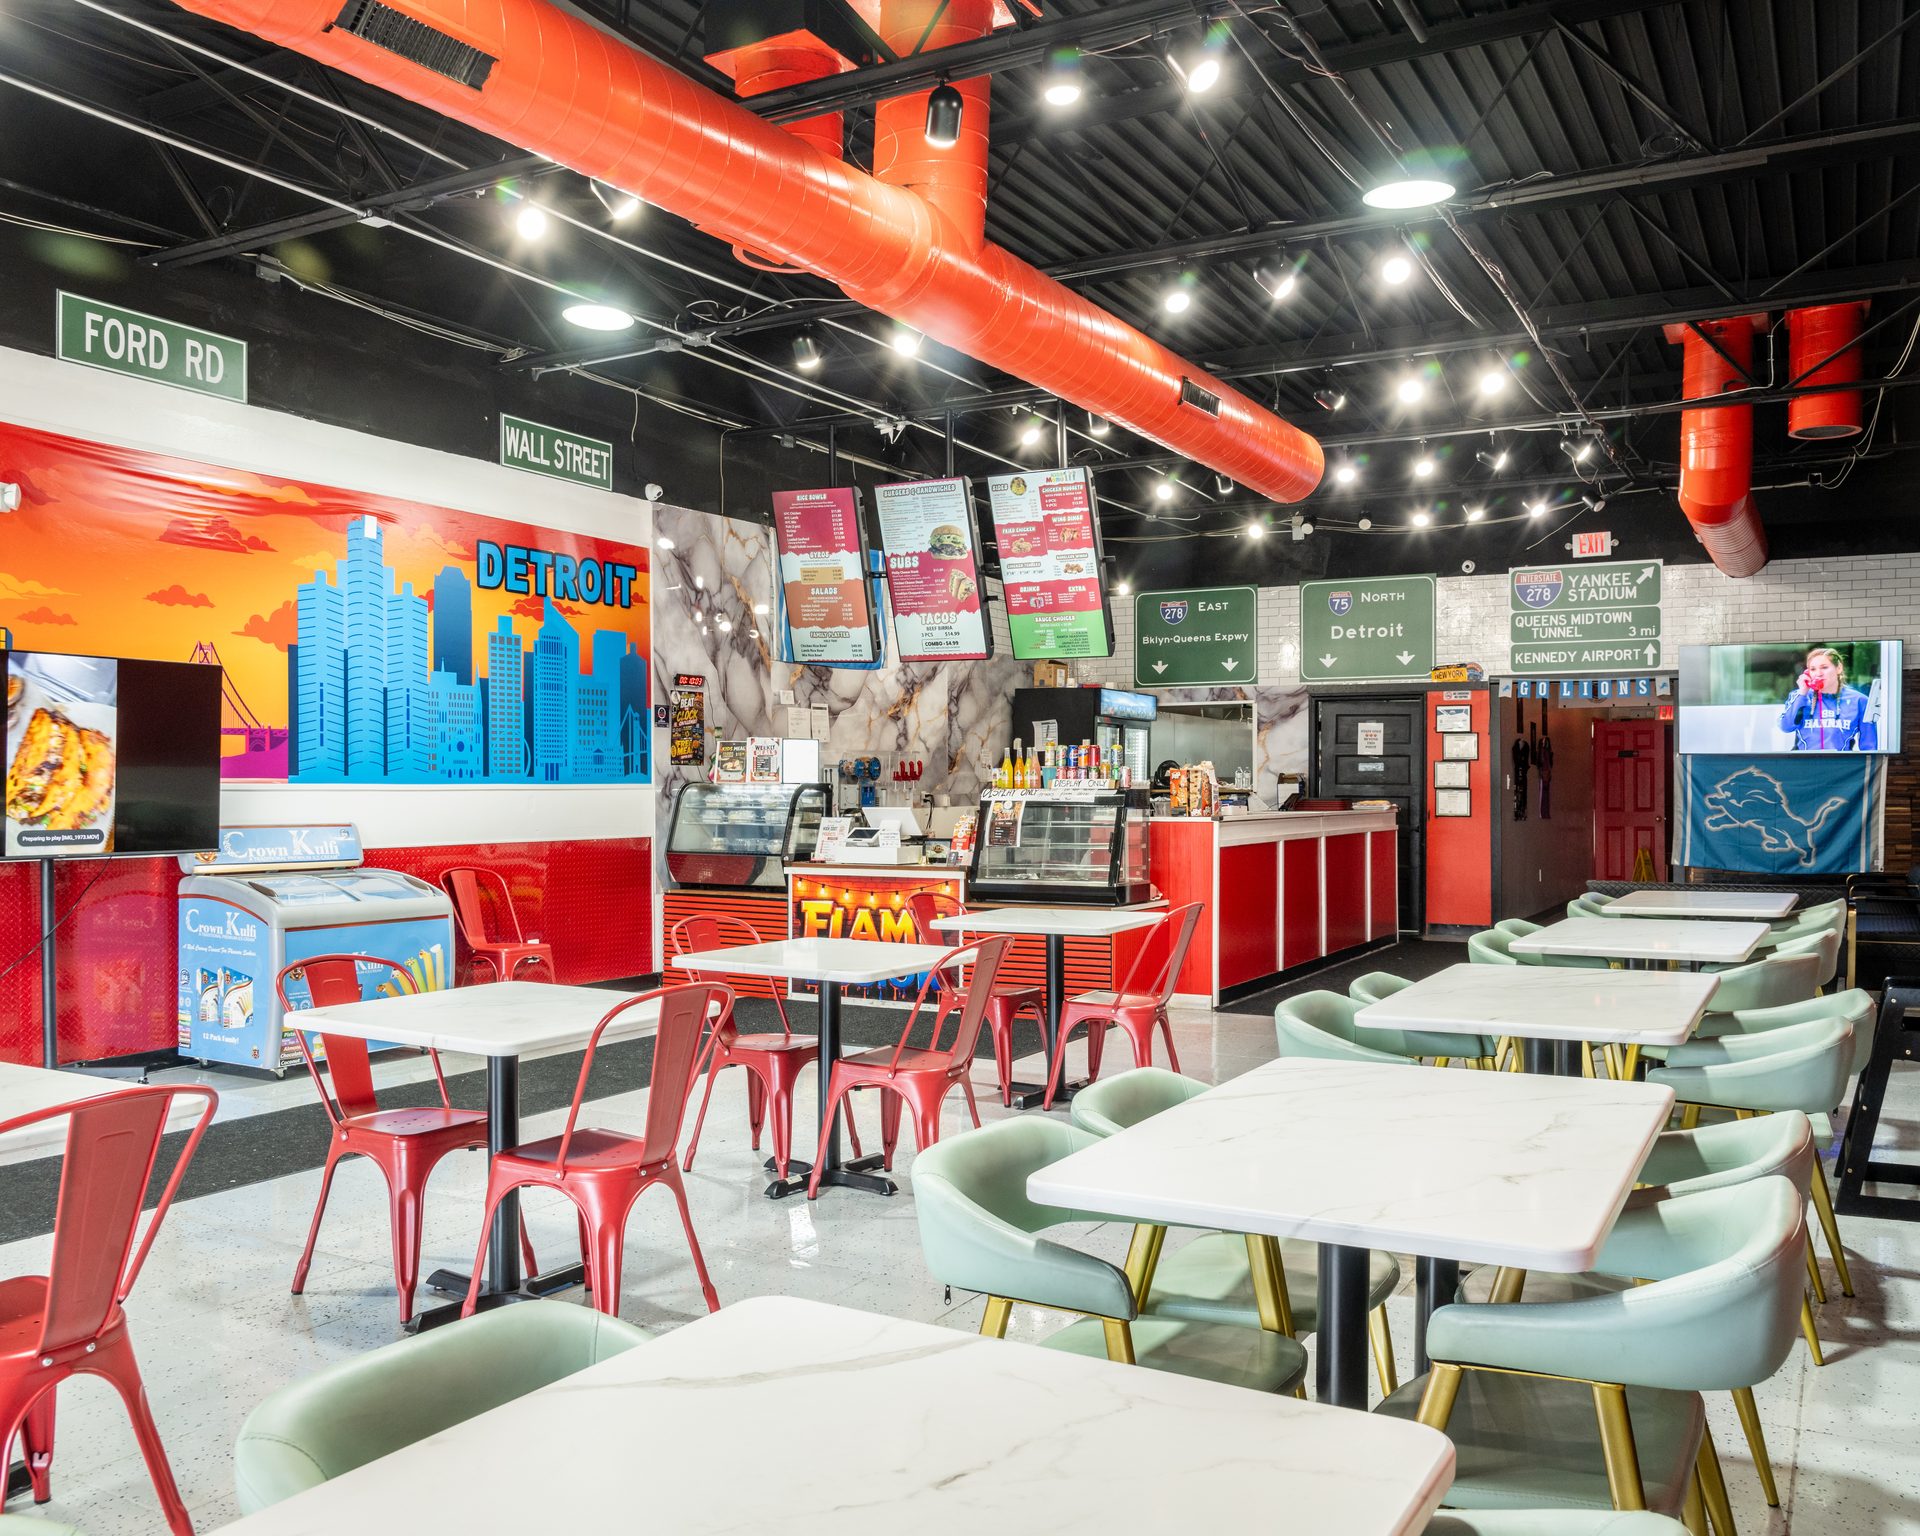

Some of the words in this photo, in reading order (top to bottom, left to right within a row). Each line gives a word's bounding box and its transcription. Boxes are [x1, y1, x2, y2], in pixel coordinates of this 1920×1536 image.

[85, 311, 169, 370] FORD
[185, 338, 225, 384] RD
[505, 425, 551, 466] WALL
[554, 438, 610, 481] STREET
[883, 488, 910, 498] BURGERS
[916, 484, 956, 495] SANDWICHES
[1579, 533, 1605, 554] EXIT
[809, 551, 830, 559] GYROS
[889, 556, 919, 569] SUBS
[477, 539, 637, 609] DETROIT
[1520, 573, 1557, 583] INTERSTATE
[1568, 572, 1631, 588] YANKEE
[811, 587, 838, 595] SALADS
[1526, 588, 1551, 602] 278
[1568, 586, 1637, 602] STADIUM
[1332, 598, 1349, 610] 75
[1361, 592, 1405, 602] NORTH
[1164, 607, 1183, 620] 278
[1198, 601, 1229, 612] EAST
[920, 612, 957, 625] TACOS
[1515, 613, 1567, 627] QUEENS
[1571, 611, 1632, 625] MIDTOWN
[1330, 623, 1404, 640] Detroit
[1532, 626, 1582, 639] TUNNEL
[1628, 626, 1637, 636] 3
[1640, 625, 1656, 636] mi
[1142, 634, 1212, 646] Bklyn-Queens
[1214, 632, 1249, 643] Expwy
[1515, 651, 1577, 664] KENNEDY
[1581, 648, 1641, 662] AIRPORT
[1434, 671, 1448, 679] NEW
[1448, 669, 1464, 678] YORK
[1519, 681, 1547, 696] GO
[1562, 679, 1648, 696] LIONS
[680, 697, 695, 708] BEAT
[676, 709, 698, 722] CLOCK
[1804, 719, 1851, 730] HANNAH
[676, 740, 693, 748] FREE
[677, 746, 694, 756] MEAL
[1054, 779, 1083, 788] DISPLAY
[1087, 779, 1107, 788] ONLY
[982, 788, 1016, 798] DISPLAY
[1020, 789, 1038, 797] ONLY
[61, 833, 100, 841] [IMG_1973.MOV]
[223, 831, 288, 858] Crown
[288, 830, 340, 857] Kulfi
[185, 908, 224, 935] Crown
[226, 911, 257, 940] Kulfi
[202, 1032, 210, 1040] 12
[210, 1033, 222, 1042] Pack
[222, 1035, 240, 1045] Family!
[280, 1058, 301, 1066] Coconut
